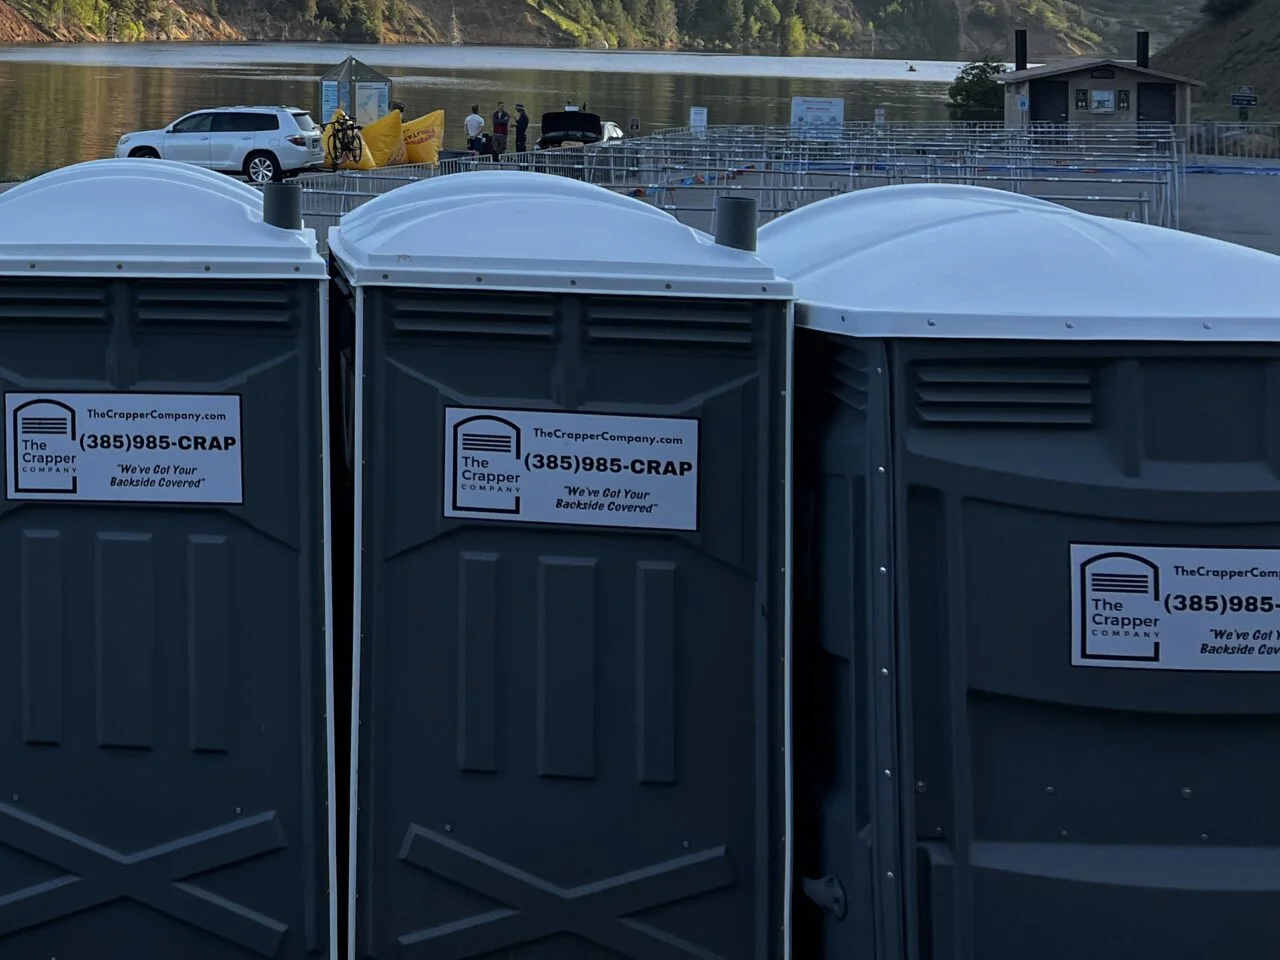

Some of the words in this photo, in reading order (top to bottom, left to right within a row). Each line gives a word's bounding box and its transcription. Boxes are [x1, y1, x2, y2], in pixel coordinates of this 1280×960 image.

[87, 409, 226, 422] TheCrapperCompany.com
[533, 428, 683, 444] TheCrapperCompany.com
[22, 440, 47, 451] The
[79, 433, 236, 452] (385)985-CRAP
[22, 453, 76, 465] Crapper
[462, 456, 489, 468] The
[524, 453, 692, 476] (385)985-CRAP
[153, 465, 171, 475] Got
[171, 466, 198, 475] Your
[110, 477, 155, 488] Backside
[158, 478, 205, 488] Covered"
[462, 470, 520, 484] Crapper
[461, 484, 520, 493] COMPANY
[602, 487, 621, 499] Got
[622, 489, 650, 500] Your
[555, 499, 605, 511] Backside
[607, 501, 658, 513] Covered"
[1173, 565, 1280, 580] TheCrapperCom
[1092, 599, 1123, 611] The
[1092, 614, 1160, 630] Crapper
[1092, 630, 1160, 638] COMPANY
[1252, 629, 1271, 640] Got
[1200, 643, 1255, 655] Backside
